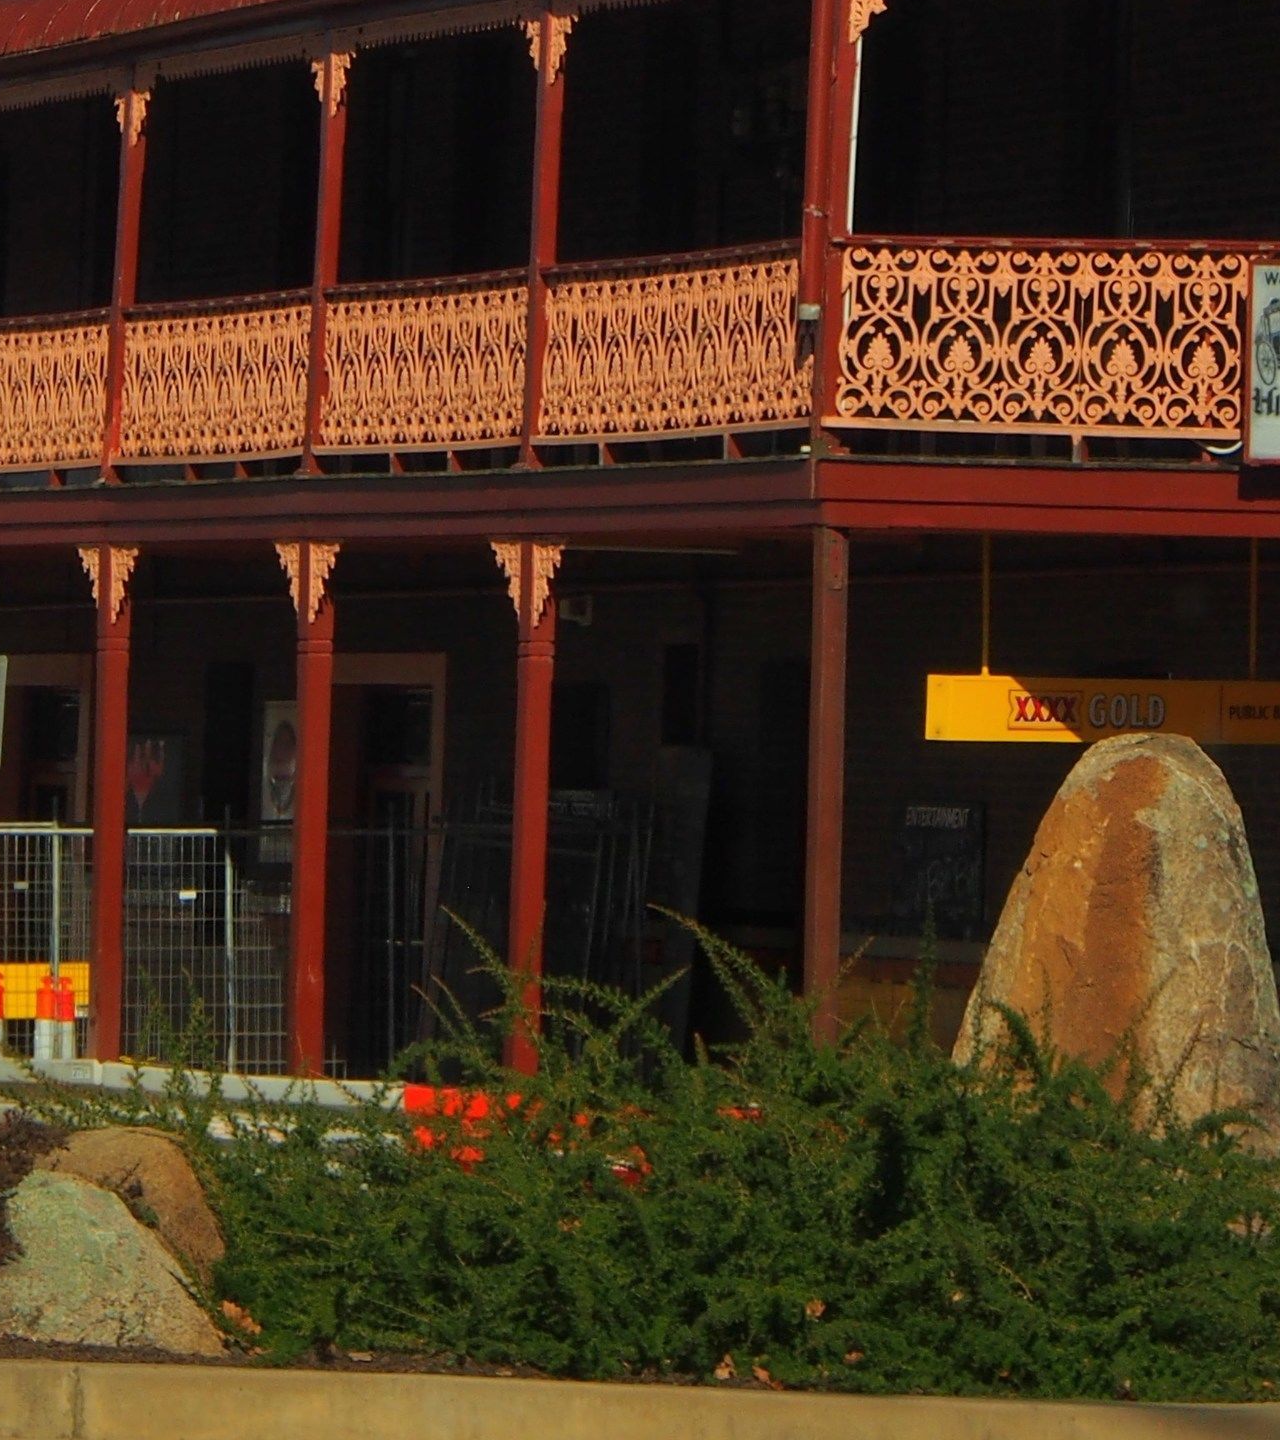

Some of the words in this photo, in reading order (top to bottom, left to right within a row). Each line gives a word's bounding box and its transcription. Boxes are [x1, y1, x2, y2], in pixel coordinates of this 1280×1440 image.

[1014, 695, 1077, 723] XXXX
[1088, 693, 1166, 729] GOLD
[1229, 704, 1269, 721] PUBLIC
